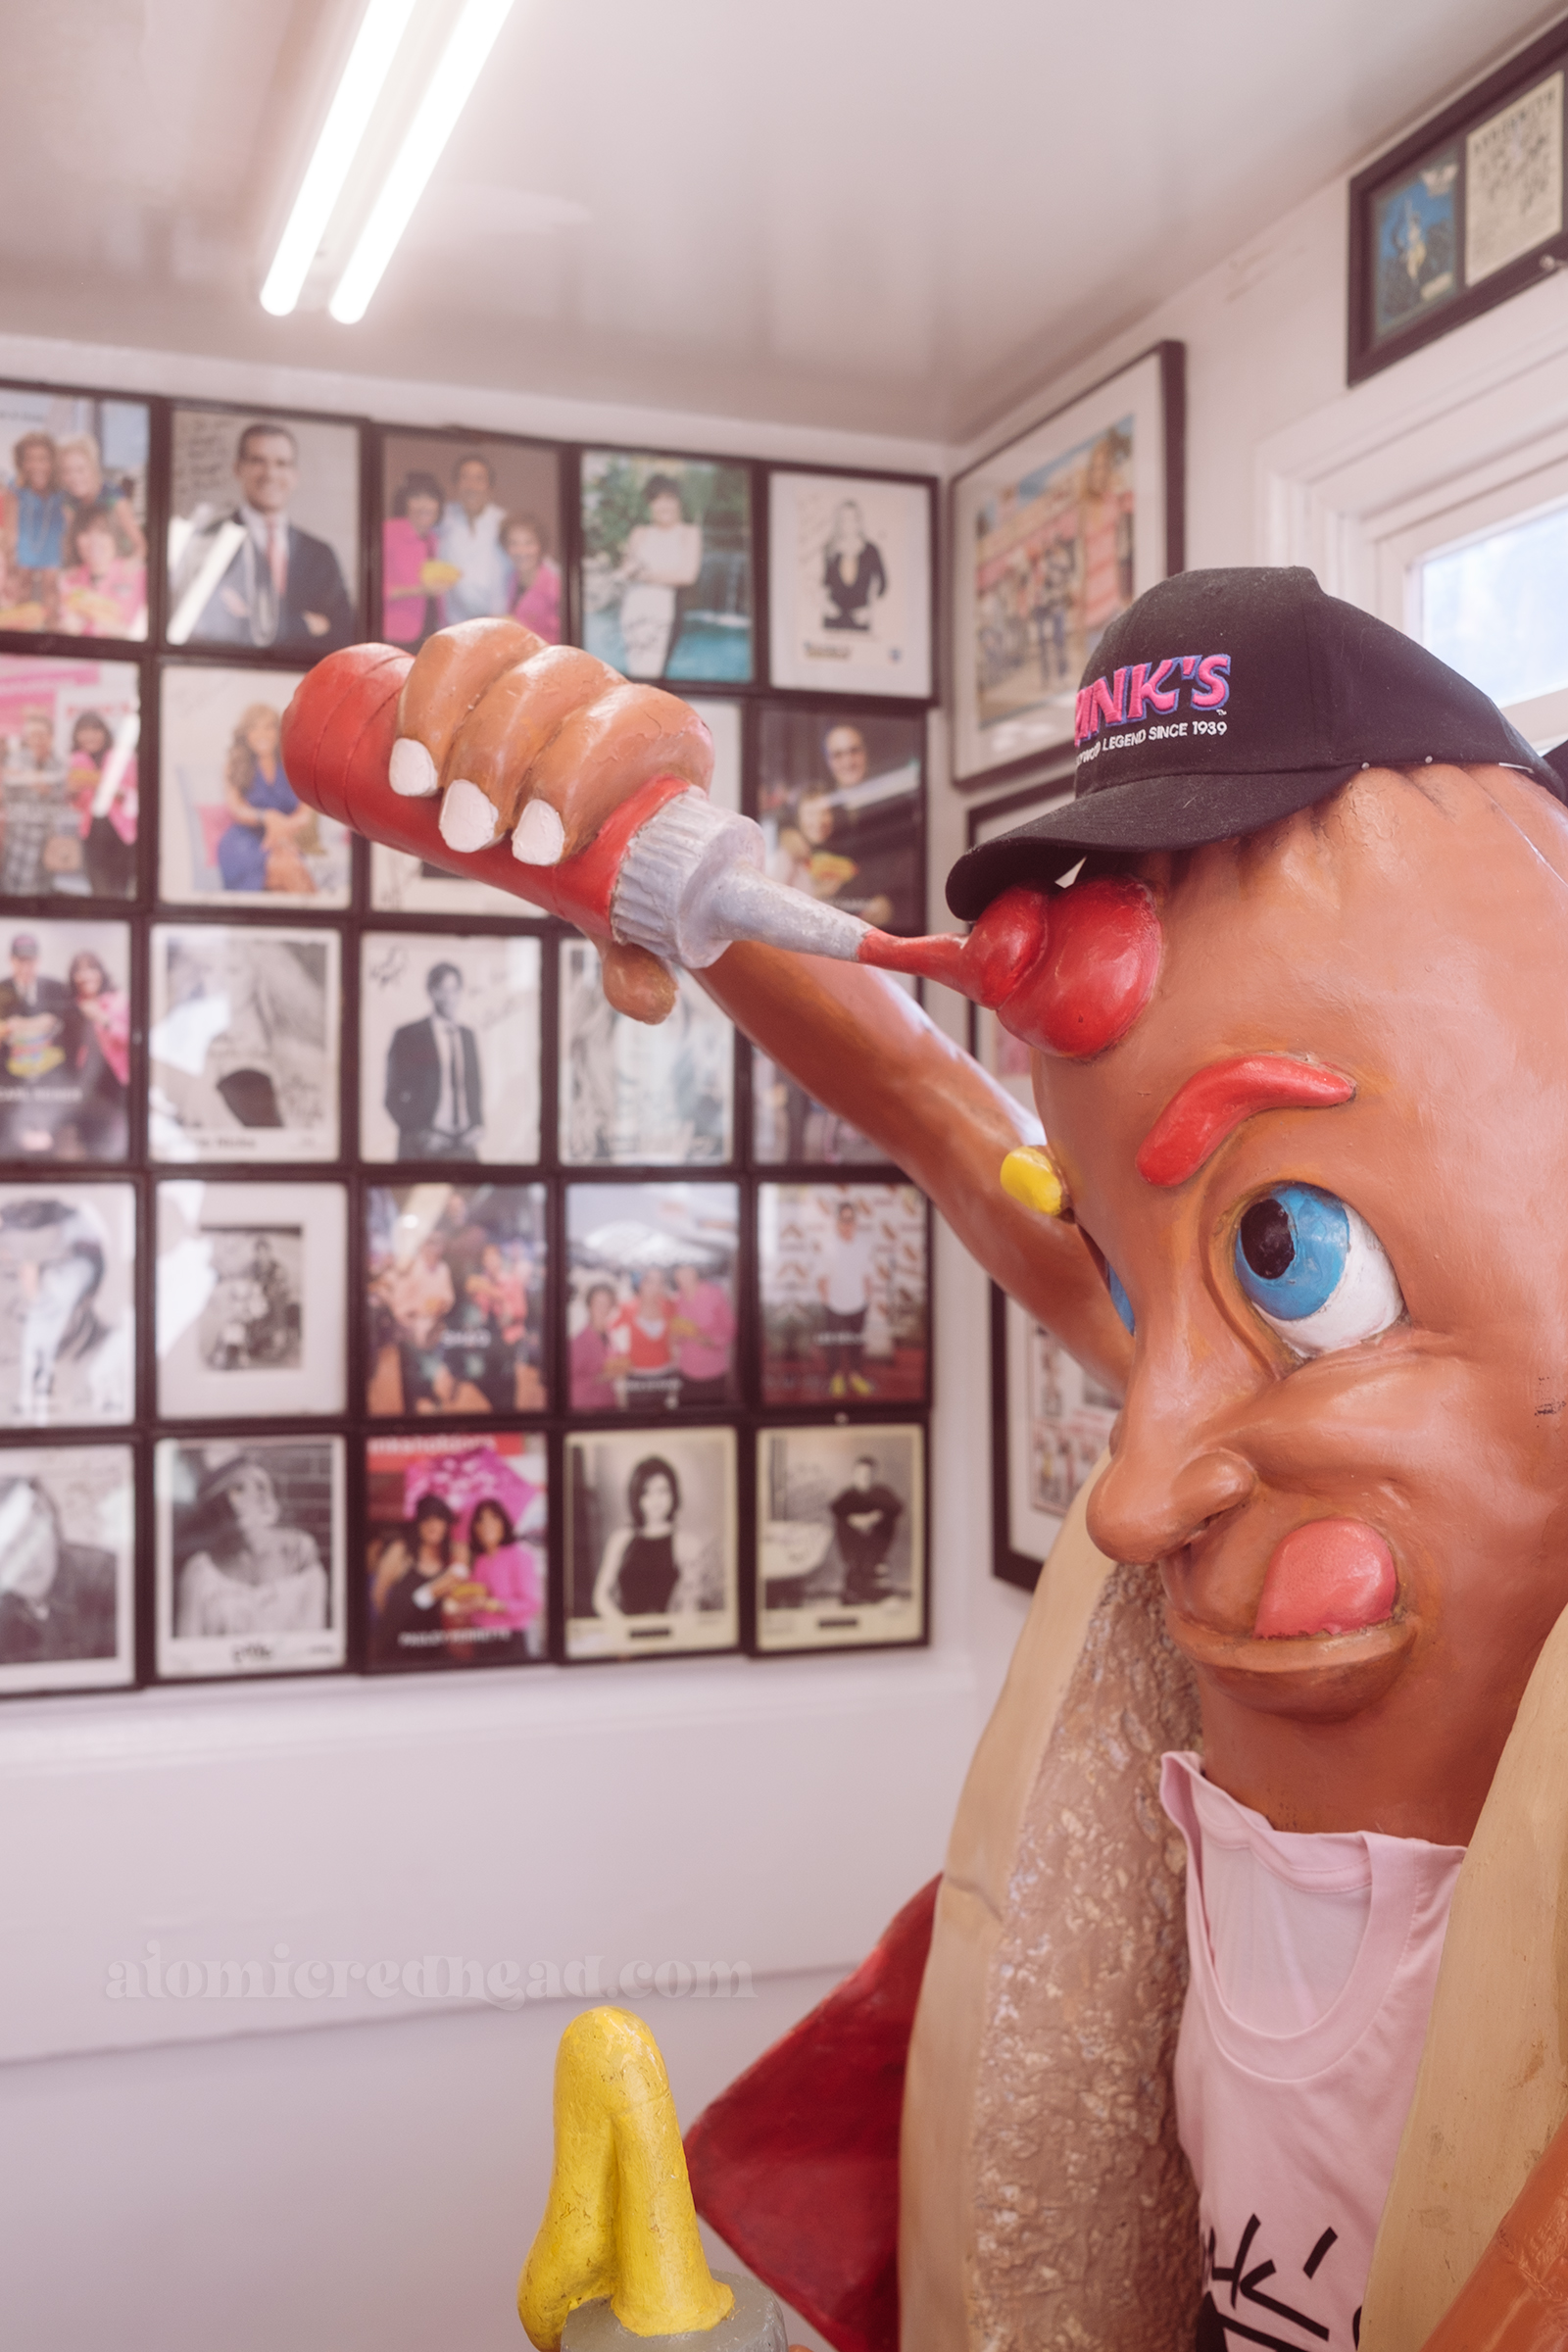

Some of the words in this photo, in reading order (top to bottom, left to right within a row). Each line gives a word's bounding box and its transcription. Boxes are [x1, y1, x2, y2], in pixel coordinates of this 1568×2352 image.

[1102, 728, 1147, 752] LEGEND
[1148, 722, 1189, 741] SINCE
[1192, 720, 1228, 736] 1939
